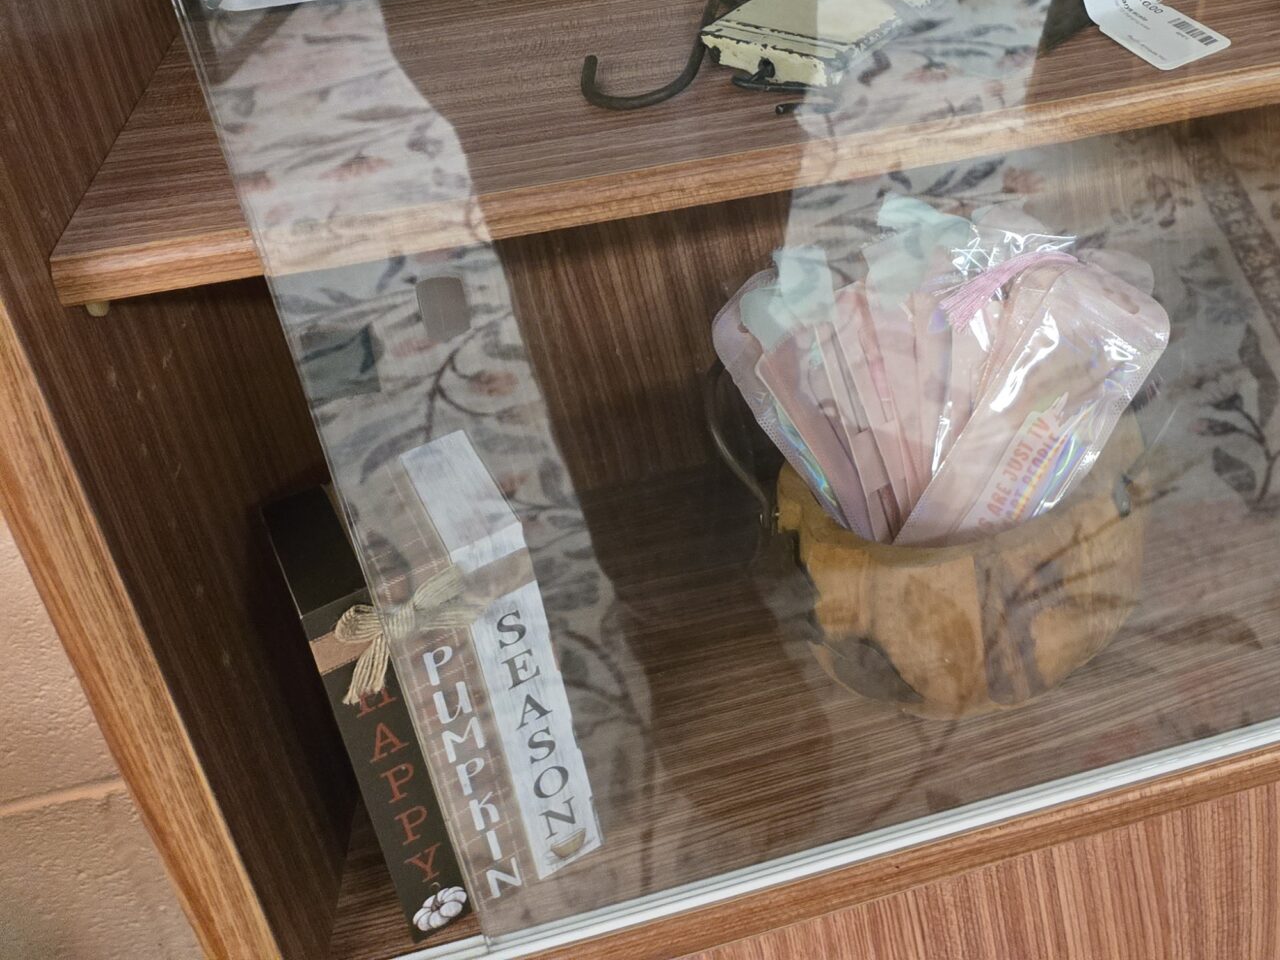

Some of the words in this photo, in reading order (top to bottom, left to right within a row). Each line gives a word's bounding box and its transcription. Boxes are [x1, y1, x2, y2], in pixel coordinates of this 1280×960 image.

[1028, 417, 1049, 439] TV
[1003, 442, 1034, 482] JUST
[987, 483, 1012, 517] ARE
[496, 611, 577, 841] SEASON
[422, 645, 522, 899] PUMPKIN
